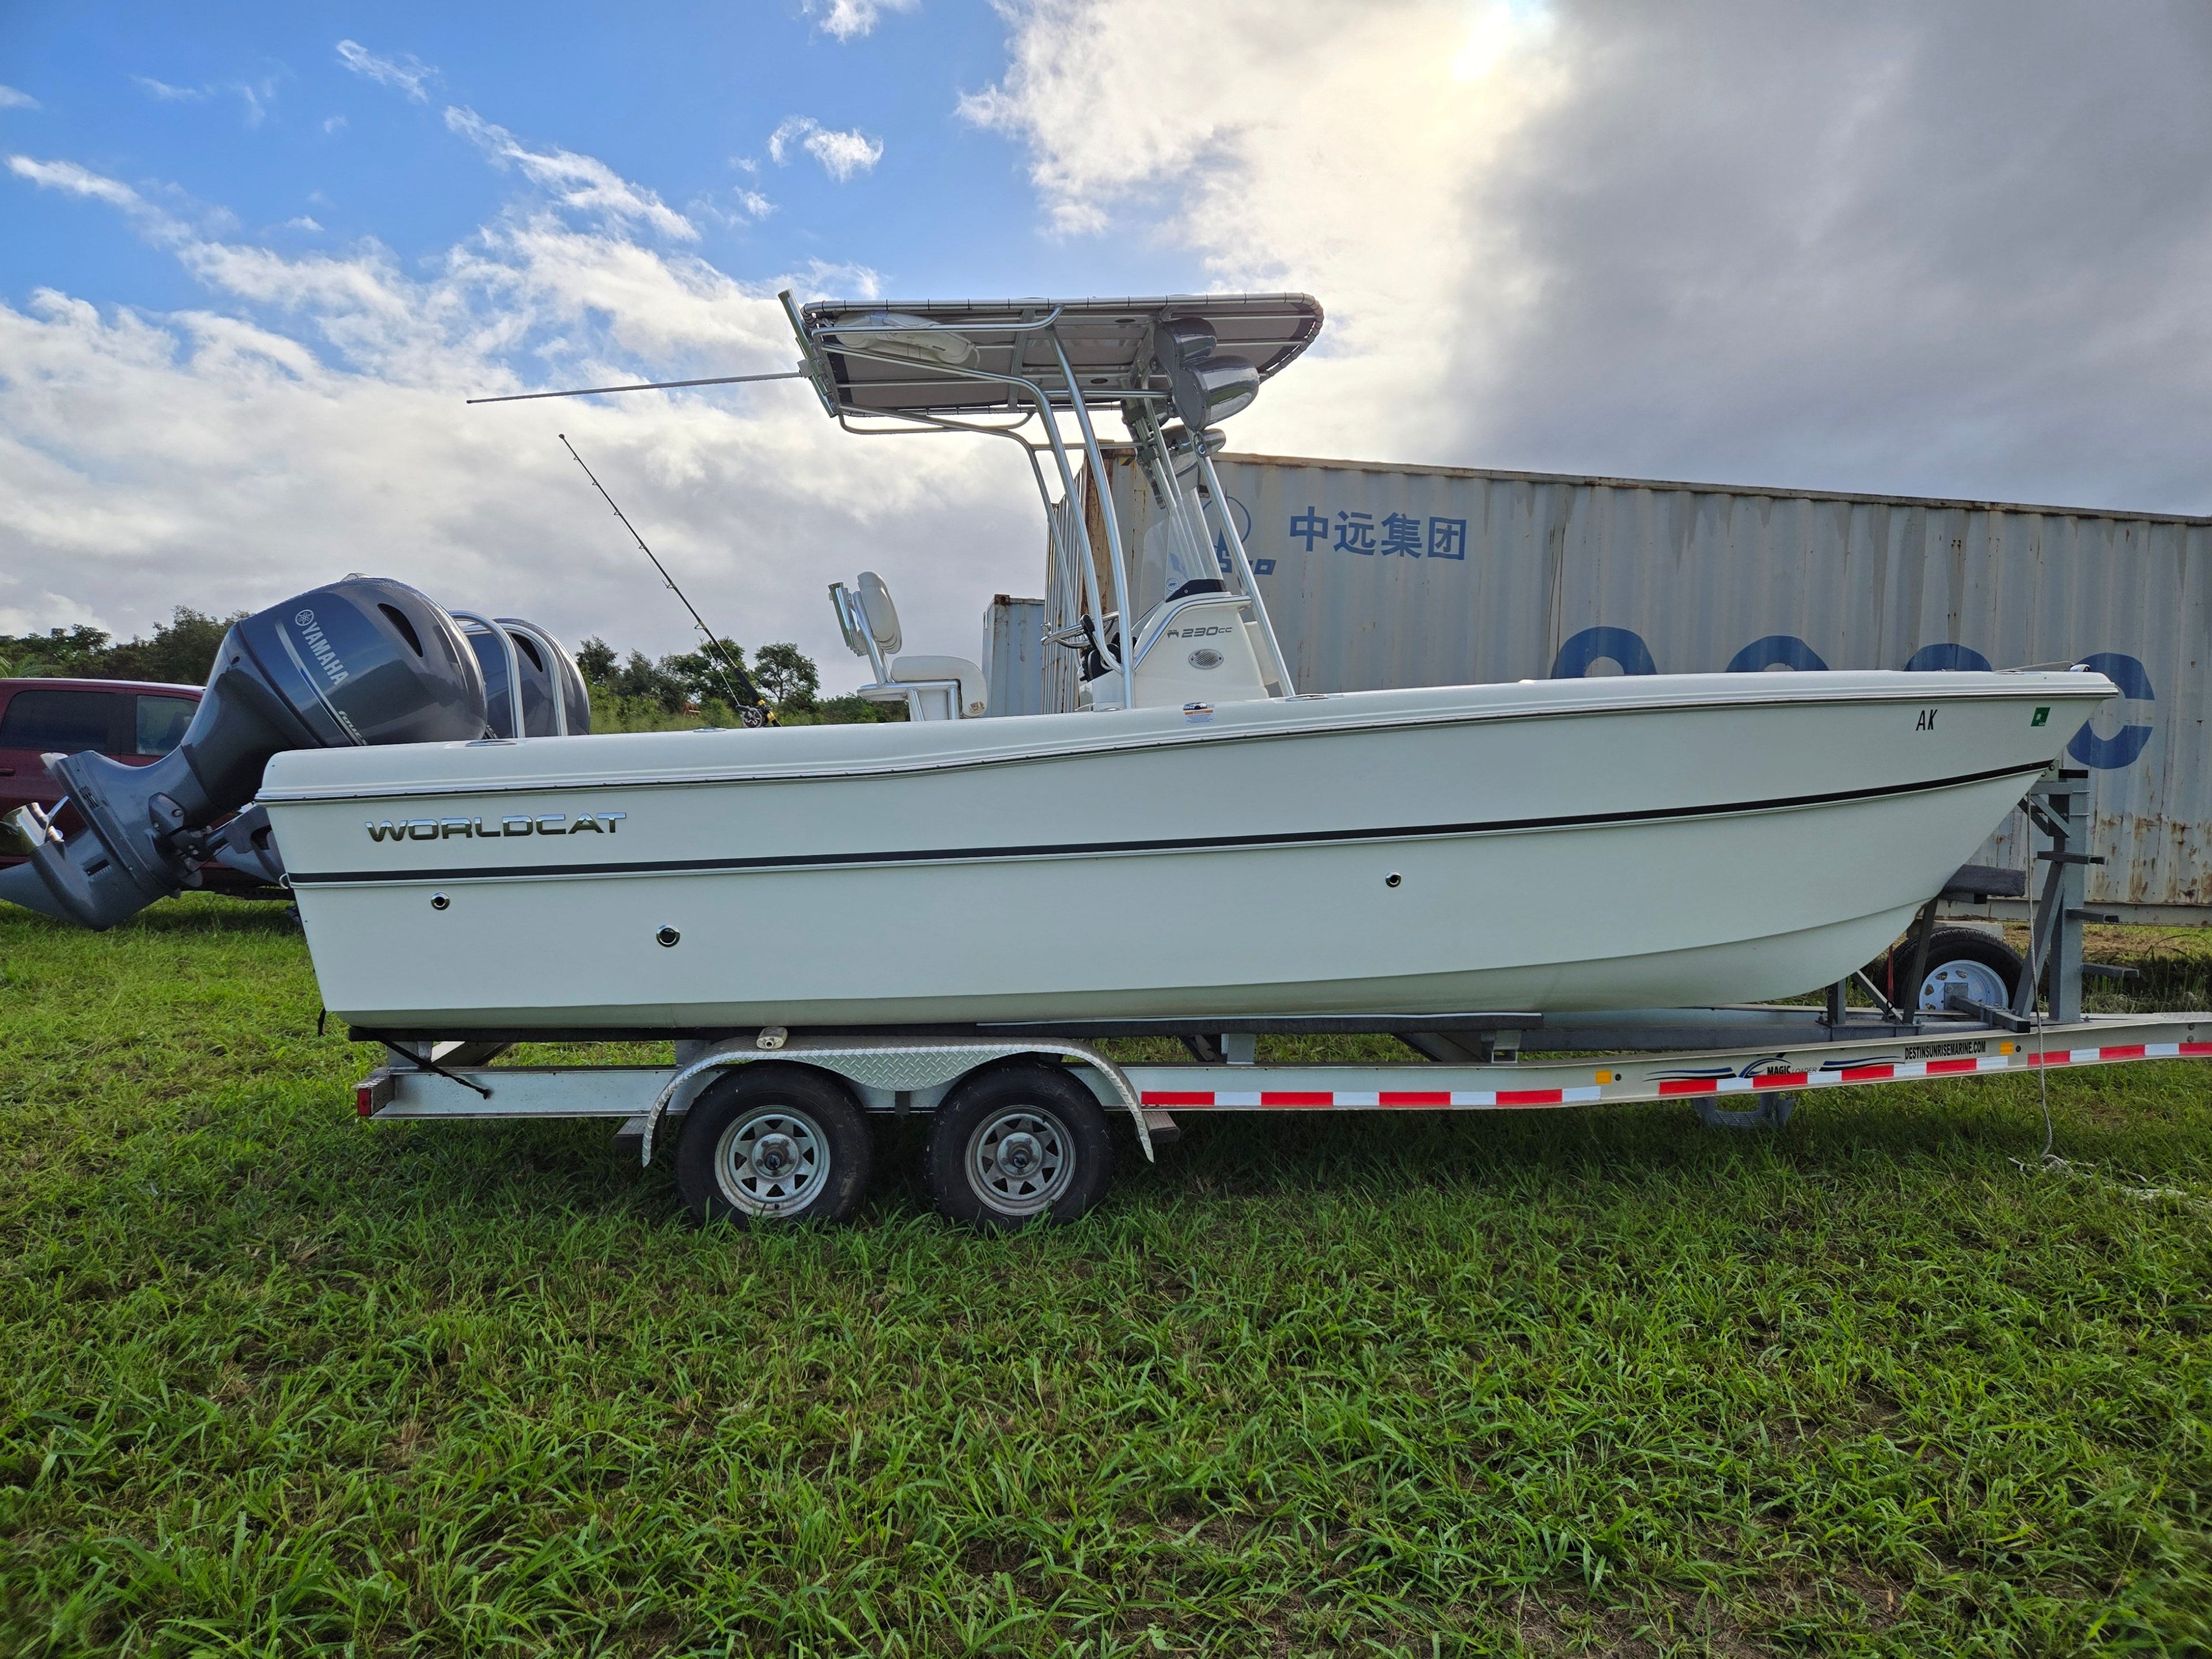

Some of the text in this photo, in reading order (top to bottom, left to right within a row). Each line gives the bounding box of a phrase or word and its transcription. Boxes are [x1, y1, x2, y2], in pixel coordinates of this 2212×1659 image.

[1289, 506, 1467, 560] 中远集团
[302, 622, 349, 686] YAMAHA
[1916, 709, 1938, 731] AK
[365, 812, 627, 842] WORLDCAT
[1905, 1040, 1986, 1060] DESTINSUNRISEMARINE.COM
[1767, 1066, 1791, 1075] MAGIC
